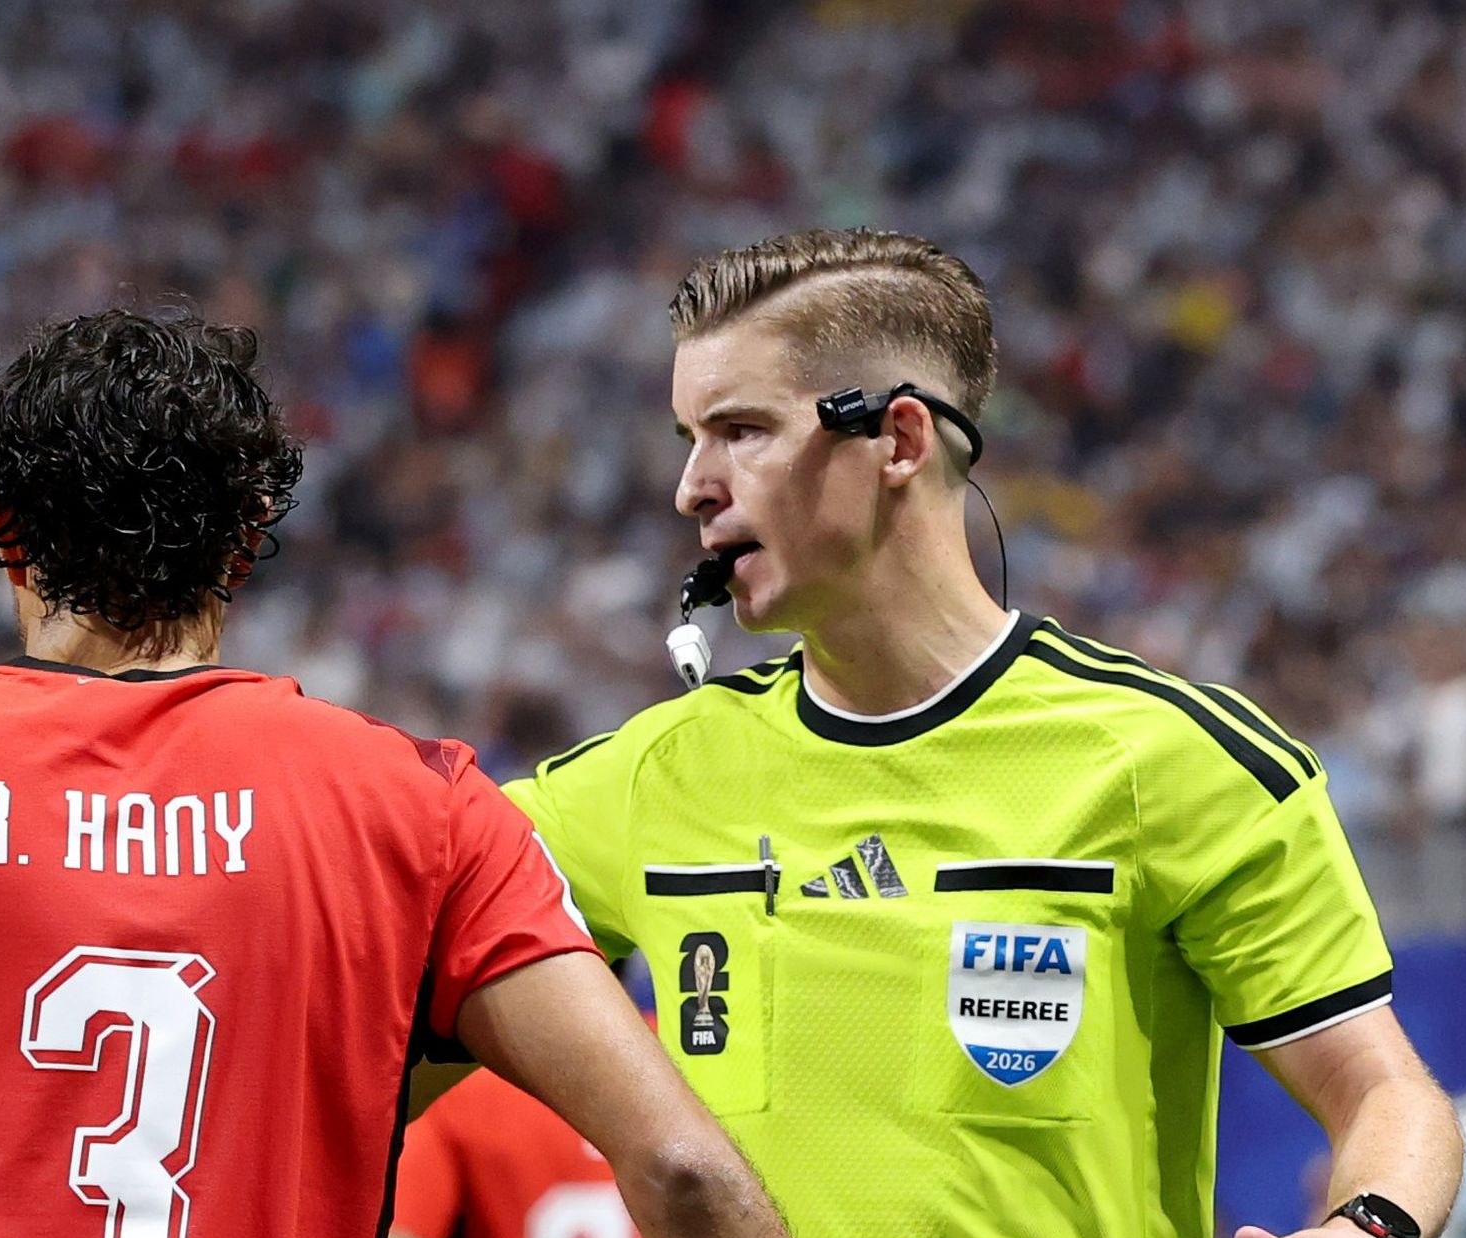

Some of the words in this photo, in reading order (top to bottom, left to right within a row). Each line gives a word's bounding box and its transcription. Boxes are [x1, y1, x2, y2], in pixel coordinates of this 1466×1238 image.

[838, 399, 864, 413] Lenovo
[63, 788, 254, 876] HANY
[962, 932, 1072, 975] FIFA
[959, 997, 1069, 1022] REFEREE
[692, 1031, 716, 1045] FIFA
[986, 1051, 1036, 1072] 2026
